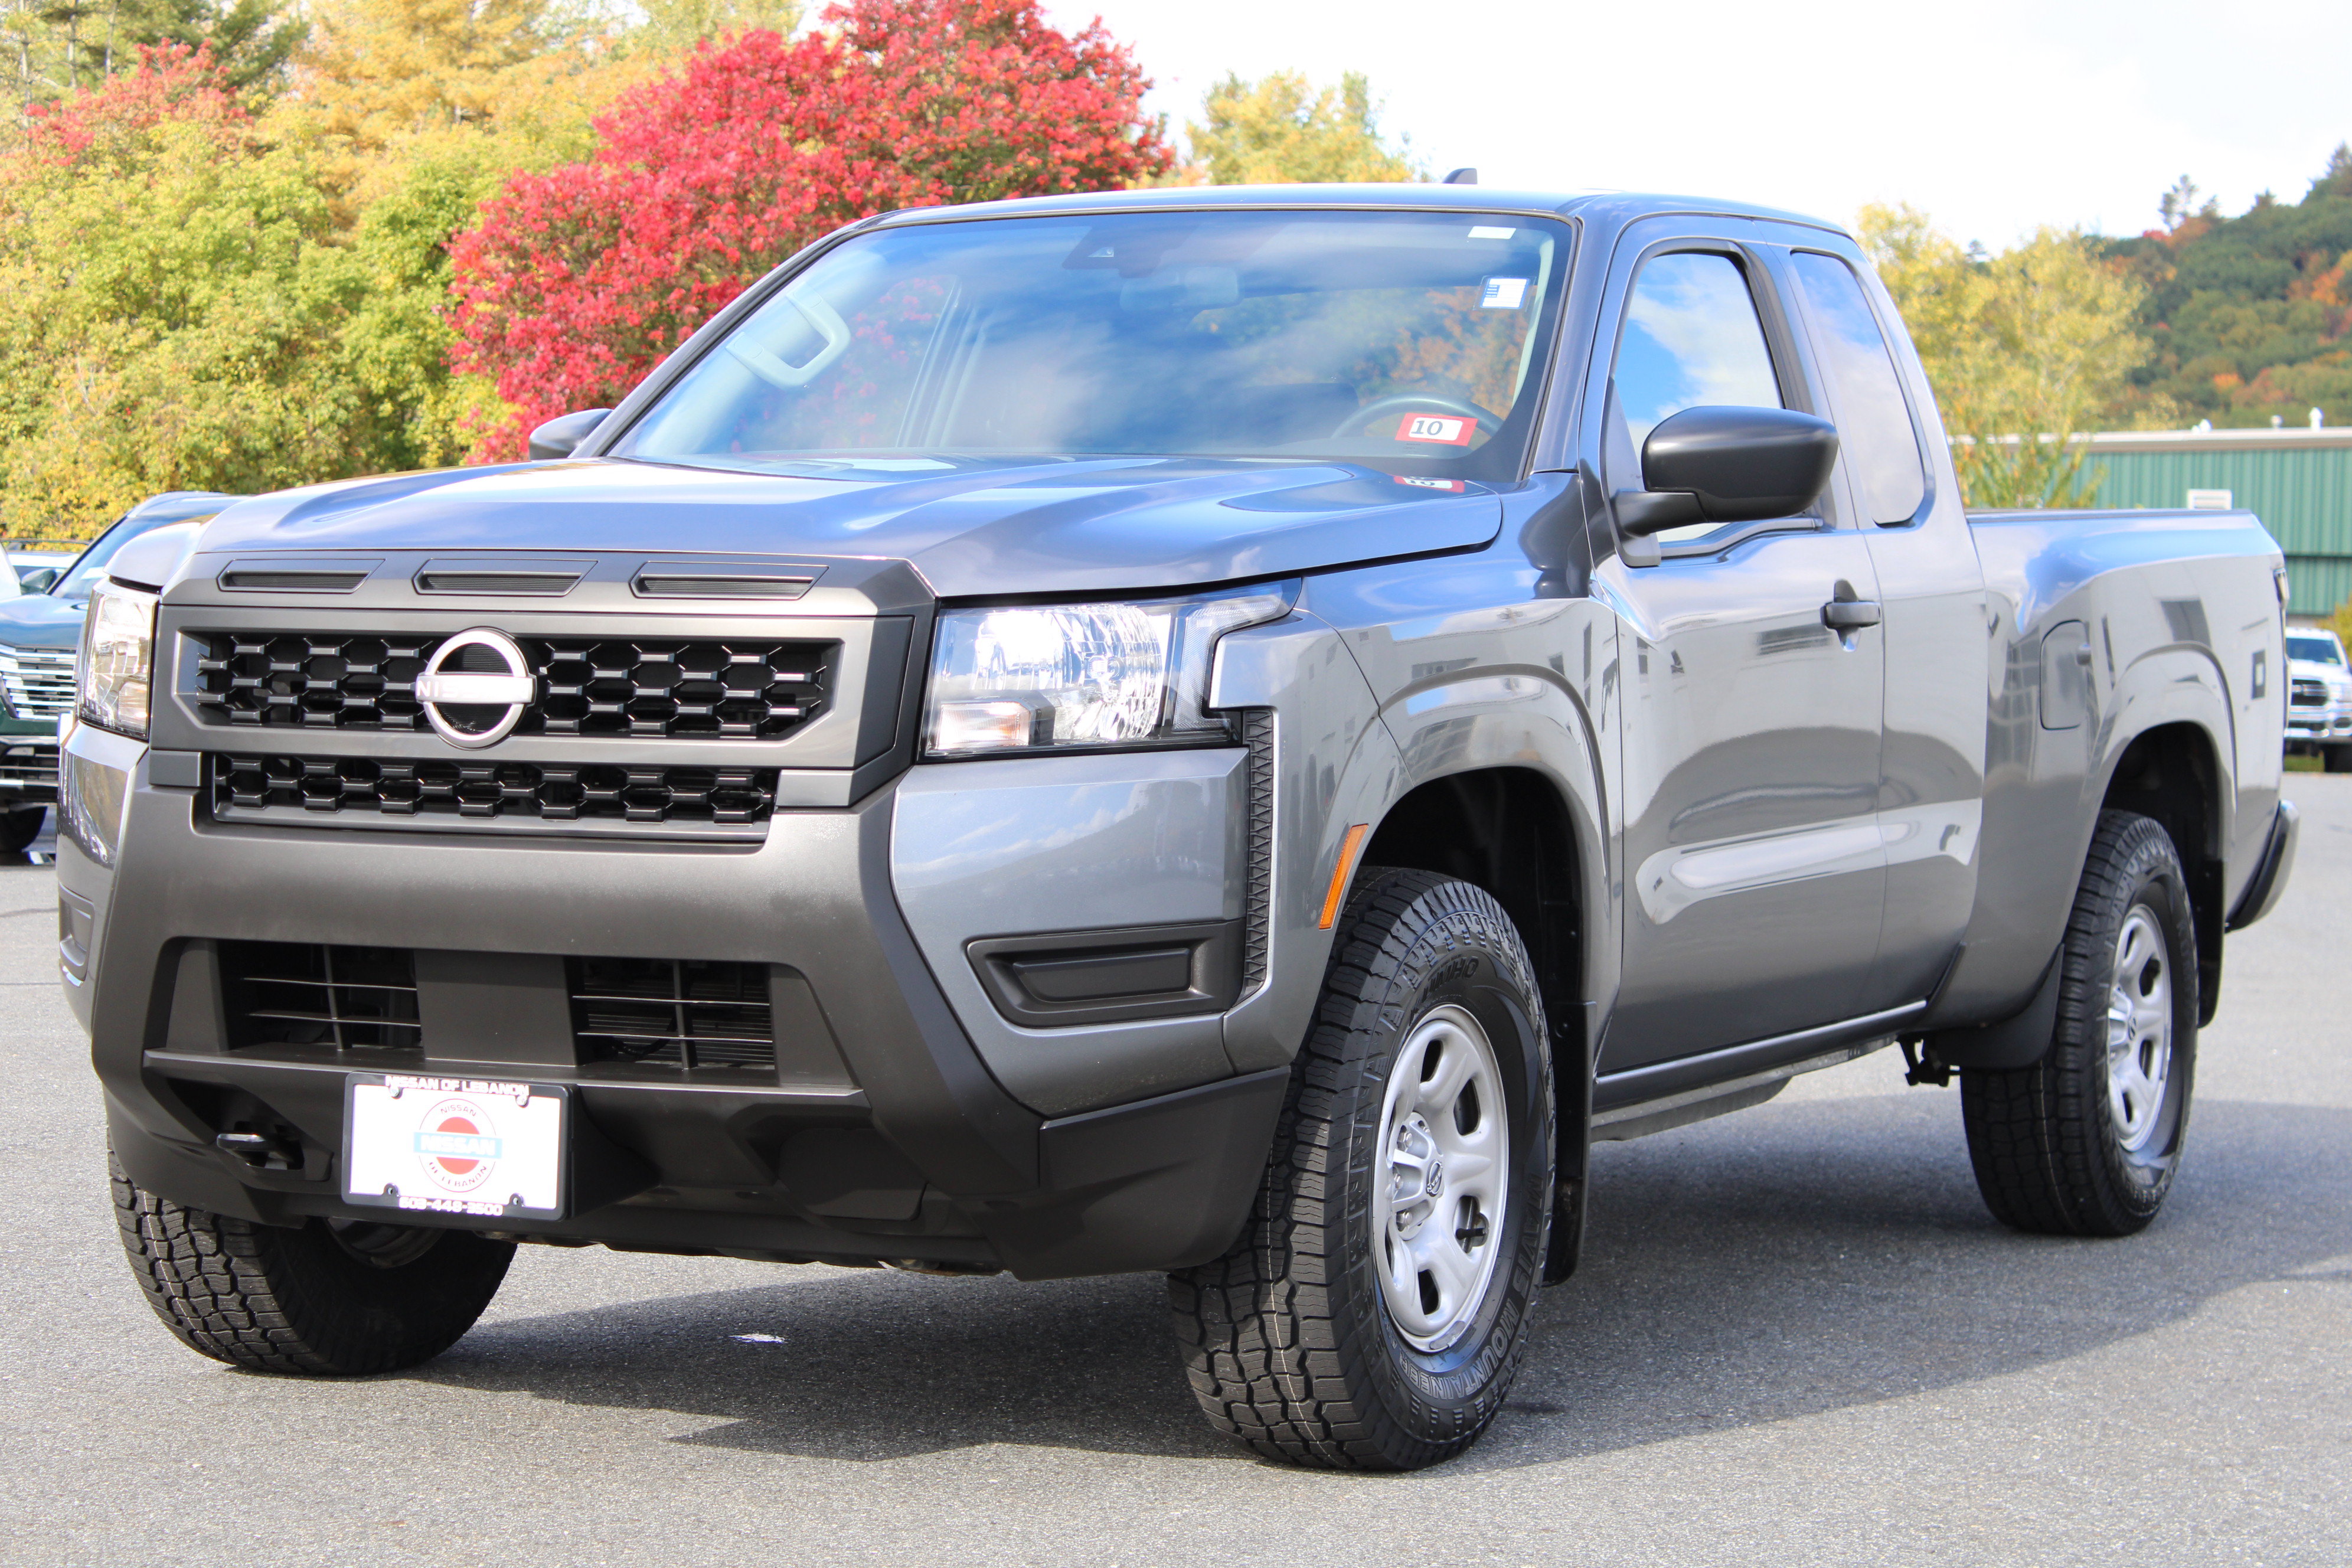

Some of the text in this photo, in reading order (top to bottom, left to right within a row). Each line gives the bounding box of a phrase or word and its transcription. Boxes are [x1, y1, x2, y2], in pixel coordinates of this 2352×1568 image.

[1411, 420, 1443, 436] 10
[416, 680, 529, 699] NISS
[386, 1075, 530, 1096] NISSAN OF LEBANON
[440, 1105, 476, 1117] NISSAN
[420, 1134, 495, 1156] NISSAN
[398, 1196, 504, 1216] 603-448-3500
[1399, 1172, 1544, 1400] MAVIS MOUNTAINEER
